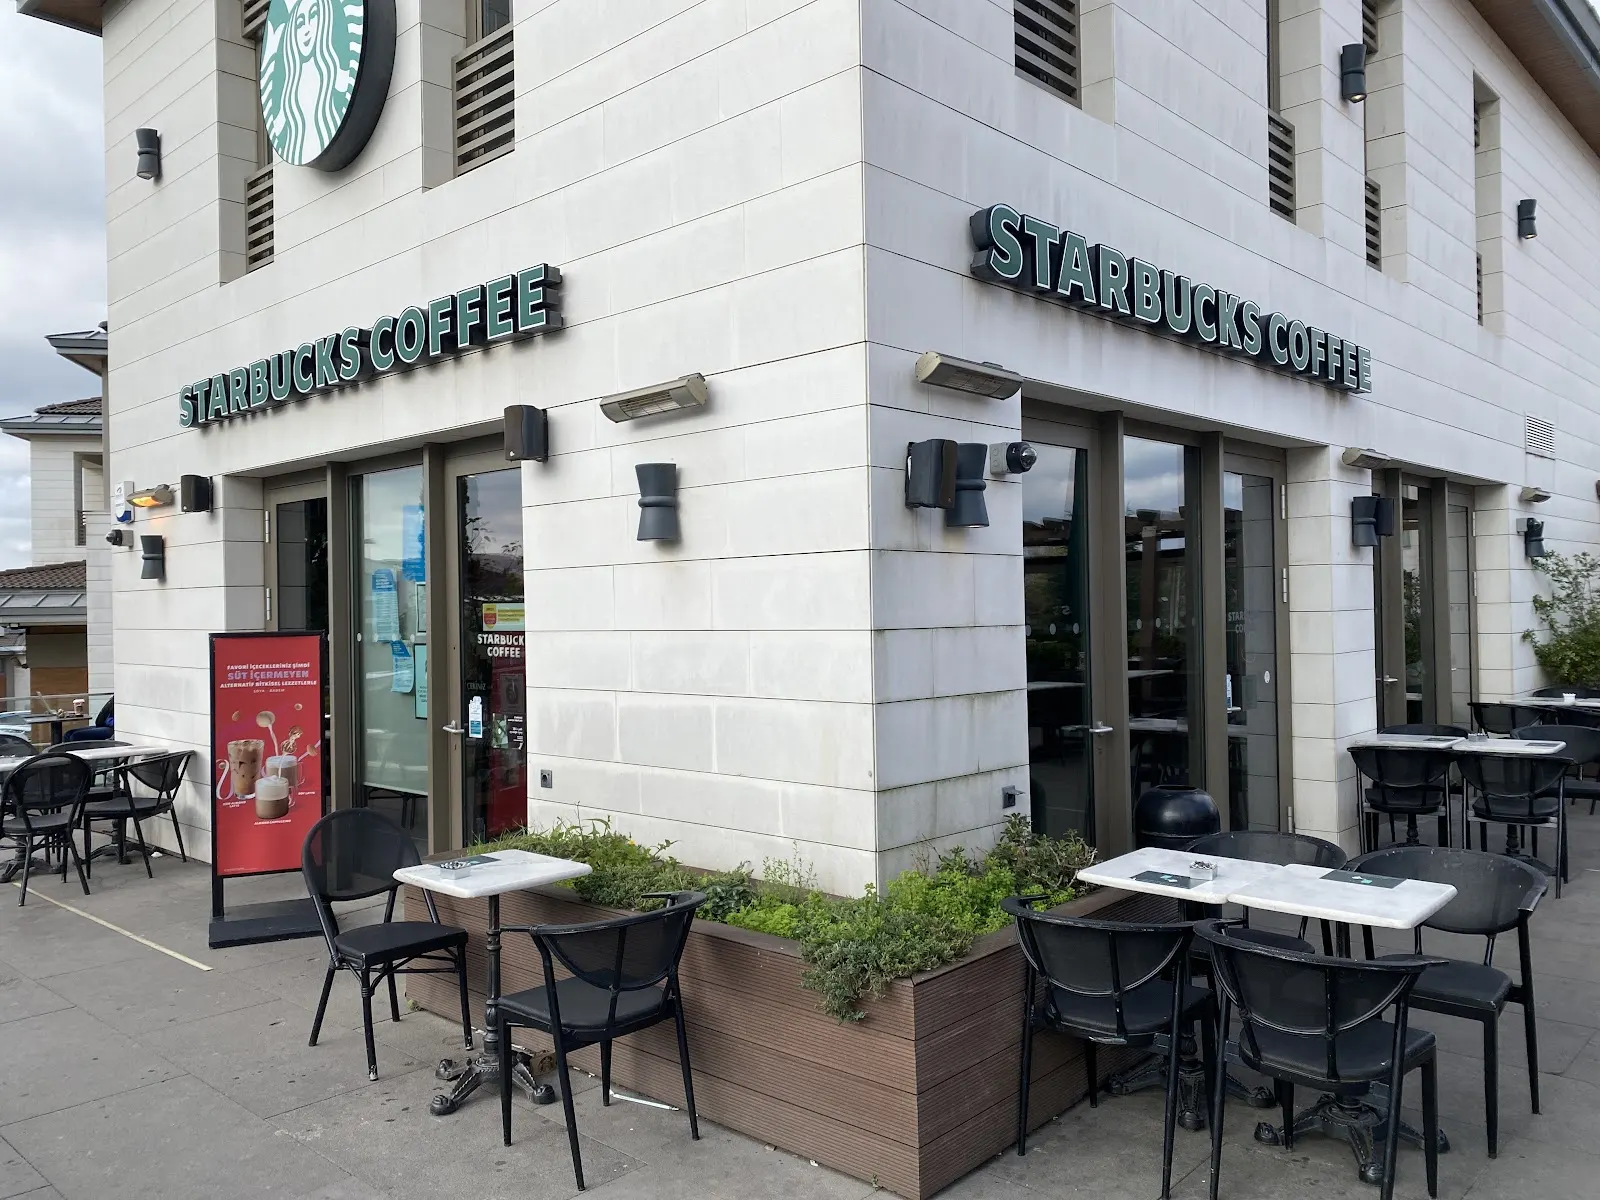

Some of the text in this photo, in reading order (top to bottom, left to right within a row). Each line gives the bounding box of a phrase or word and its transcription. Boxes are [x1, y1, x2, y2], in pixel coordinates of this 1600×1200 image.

[989, 202, 1372, 394] STARBUCKS COFFEE
[178, 262, 547, 428] STARBUCKS COFFEE
[477, 633, 525, 646] STARBUCK
[487, 646, 521, 658] COFFEE
[227, 670, 309, 681] SÜT İÇERMEYEN
